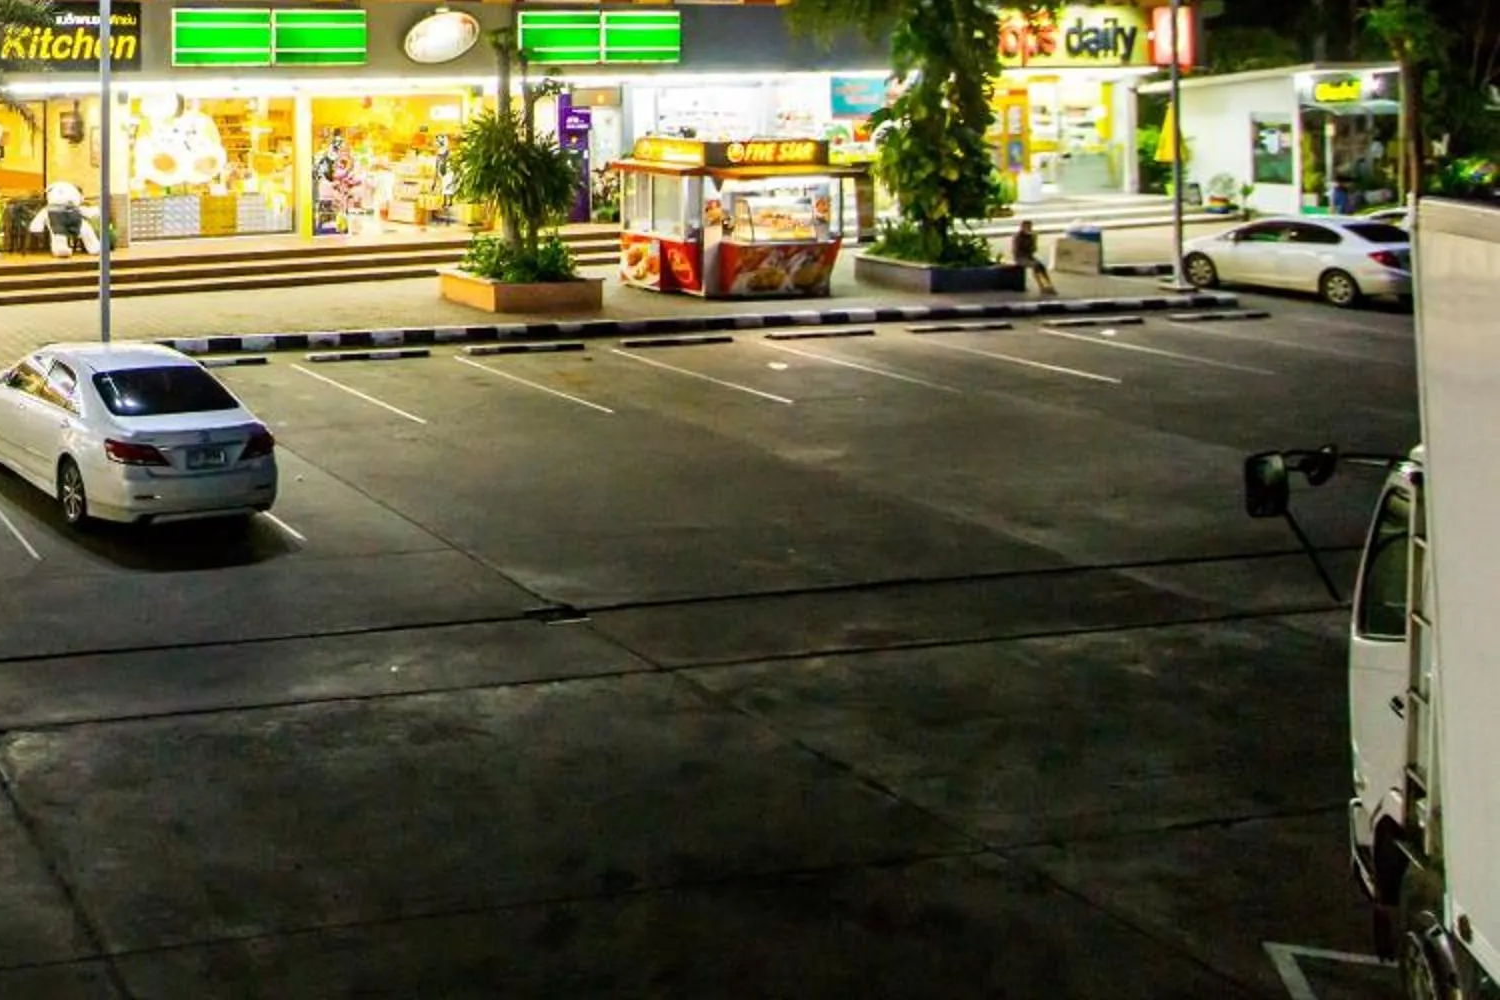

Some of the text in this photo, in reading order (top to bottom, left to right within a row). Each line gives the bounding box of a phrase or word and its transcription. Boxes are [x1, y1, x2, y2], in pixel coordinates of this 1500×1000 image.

[1, 25, 137, 60] Kitchen
[998, 17, 1138, 68] ops daily
